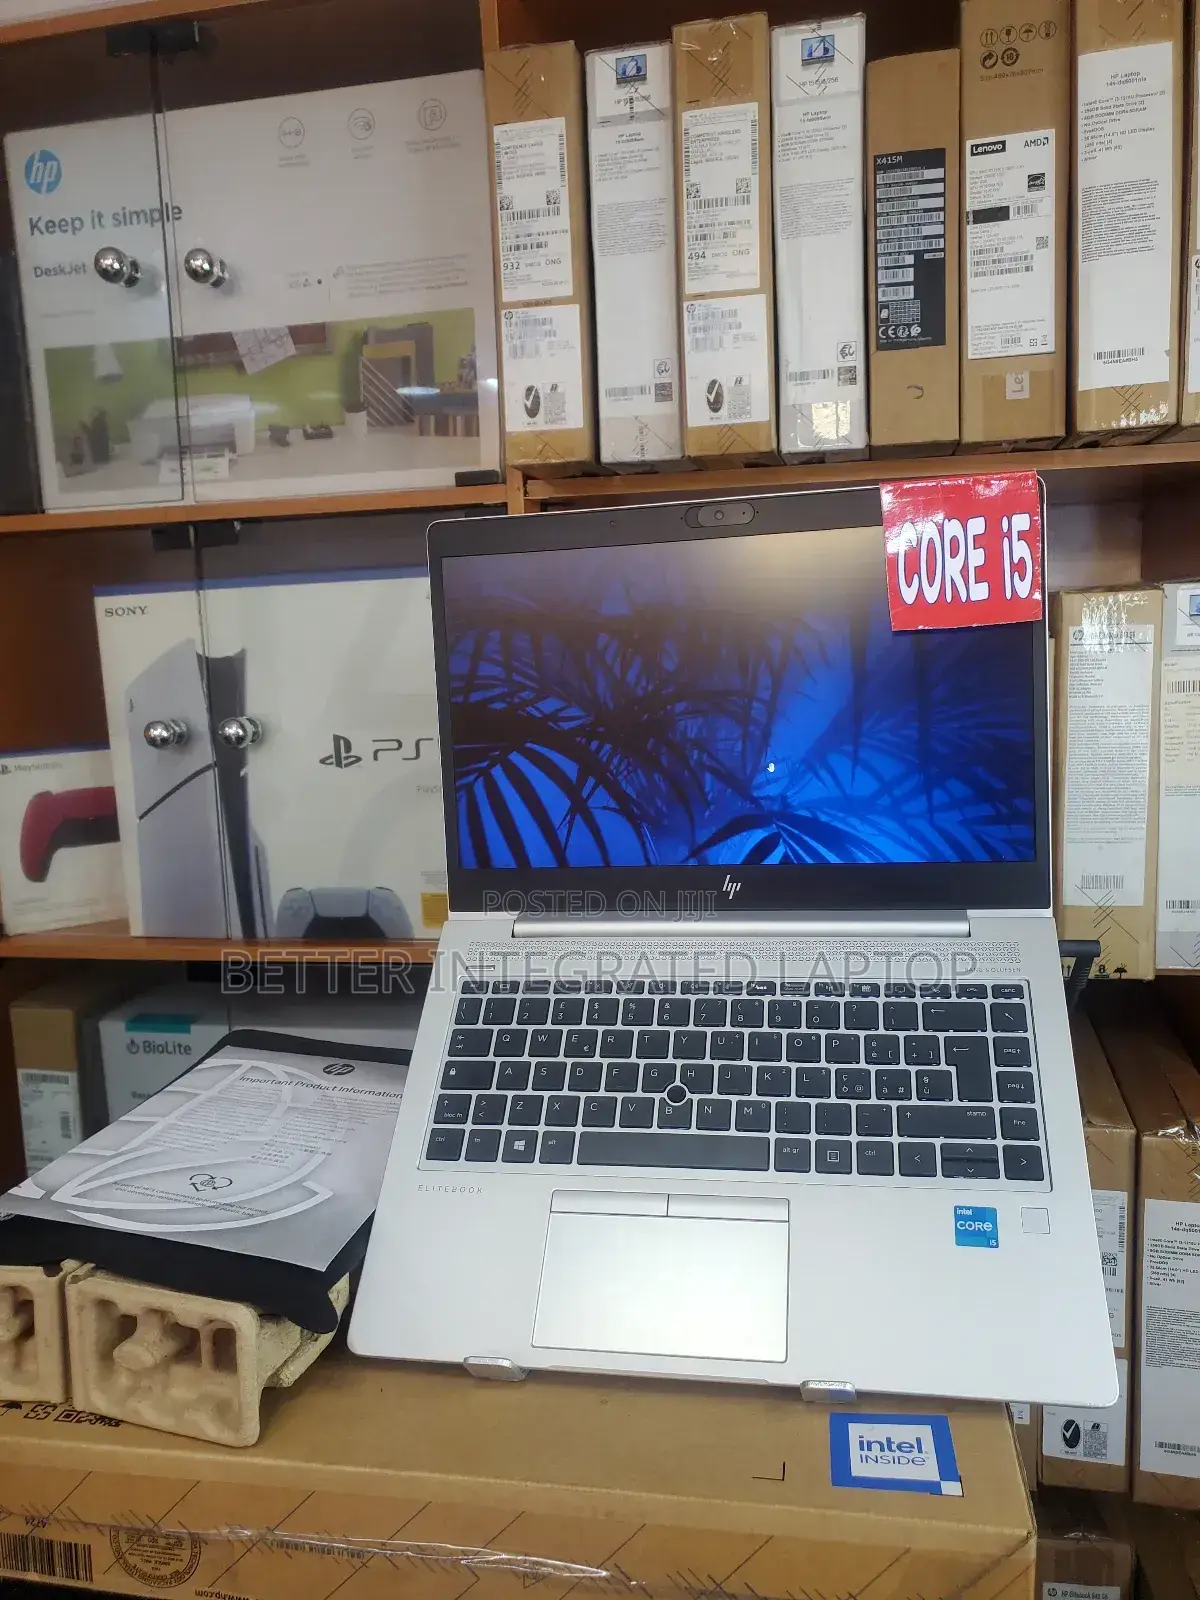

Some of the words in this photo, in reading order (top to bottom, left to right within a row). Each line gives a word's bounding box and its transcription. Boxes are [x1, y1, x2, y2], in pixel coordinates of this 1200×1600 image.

[1120, 71, 1141, 79] Laptop
[973, 143, 1003, 154] Lenovo
[1023, 138, 1042, 148] AMD
[28, 215, 84, 236] Keep
[90, 210, 105, 230] it
[111, 202, 183, 228] simple
[687, 251, 706, 260] 494
[732, 248, 750, 257] ONG
[502, 261, 521, 271] 932
[544, 258, 562, 266] ONG
[33, 262, 87, 278] DeskJet
[897, 515, 990, 605] CORE
[1001, 512, 1034, 601] i5
[104, 605, 149, 618] SONY
[722, 875, 742, 899] hp
[592, 1012, 599, 1020] 4
[737, 1014, 744, 1022] 8
[502, 1034, 511, 1042] Q
[537, 1034, 549, 1042] W
[571, 1034, 579, 1042] E
[607, 1035, 615, 1043] R
[643, 1035, 651, 1043] T
[680, 1035, 688, 1044] Y
[717, 1036, 726, 1045] U
[794, 1038, 803, 1047] O
[142, 1040, 192, 1055] BioLite
[832, 1039, 840, 1048] P
[504, 1067, 513, 1075] A
[540, 1067, 548, 1076] S
[576, 1067, 584, 1076] D
[612, 1068, 620, 1076] F
[650, 1069, 658, 1077] G
[687, 1069, 695, 1078] H
[725, 1070, 731, 1079] J
[764, 1072, 772, 1081] K
[803, 1073, 810, 1082] L
[239, 1075, 293, 1086] Important
[295, 1080, 339, 1093] Product
[338, 1086, 403, 1099] Information
[516, 1101, 524, 1110] Z
[553, 1102, 561, 1110] X
[590, 1102, 598, 1111] C
[628, 1103, 636, 1112] V
[704, 1105, 712, 1114] N
[665, 1106, 673, 1115] B
[743, 1106, 753, 1116] M
[417, 1184, 484, 1194] ELITEBOOK
[956, 1208, 973, 1216] intel
[989, 1238, 997, 1246] i5
[858, 1435, 923, 1454] intel
